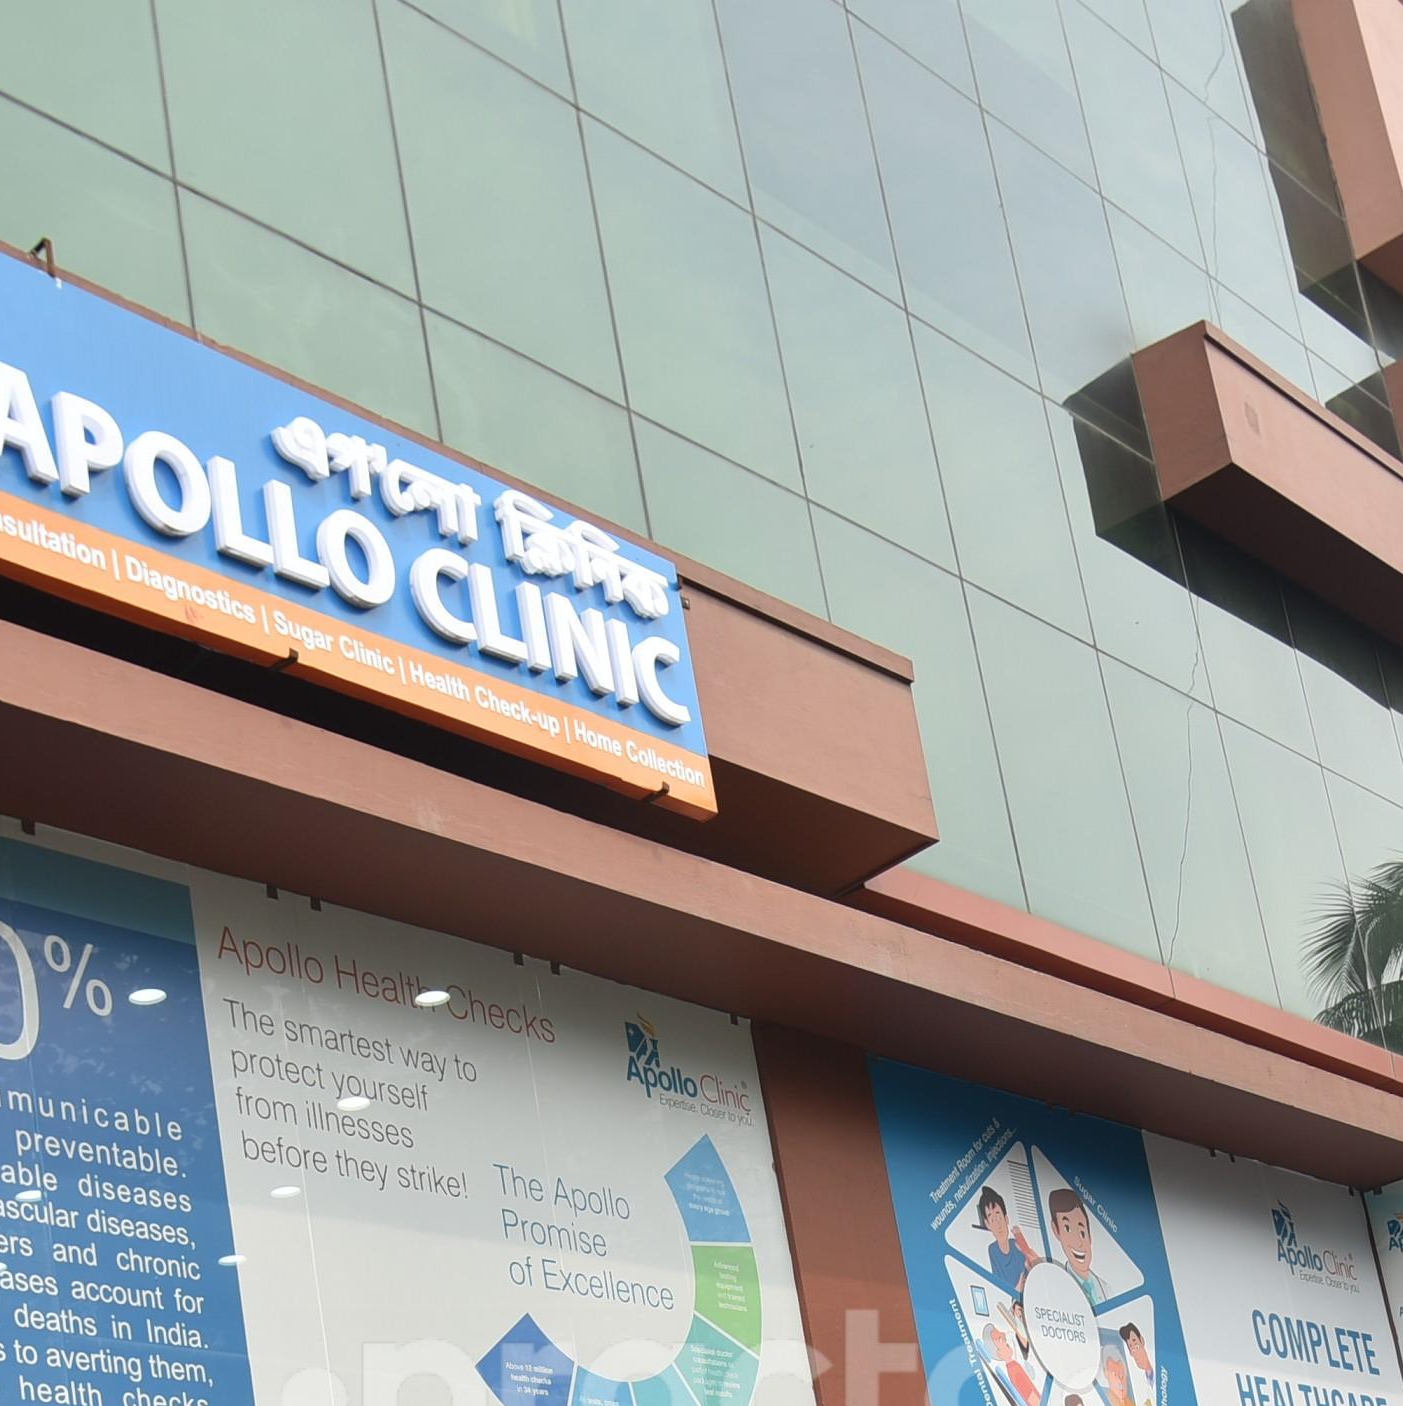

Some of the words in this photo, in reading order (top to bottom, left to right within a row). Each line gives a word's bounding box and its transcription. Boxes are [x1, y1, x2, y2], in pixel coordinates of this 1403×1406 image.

[410, 547, 692, 728] CLINIC
[126, 556, 258, 625] Diagnostics
[274, 610, 334, 652] Sugar
[339, 636, 395, 675] Clinic
[410, 664, 471, 703] Health
[475, 687, 561, 738] Check-up
[574, 720, 623, 757] Home
[626, 740, 706, 788] Collection
[217, 926, 324, 986] Apollo
[446, 984, 556, 1044] Checks
[223, 998, 275, 1037] The
[284, 1015, 393, 1065] smartest
[399, 1046, 448, 1082] way
[453, 1054, 477, 1082] to
[231, 1047, 324, 1090] protect
[332, 1069, 429, 1112] yourself
[627, 1055, 698, 1098] Apollo
[700, 1074, 752, 1112] Clinic
[236, 1087, 297, 1126] from
[306, 1101, 414, 1149] illnesses
[16, 1127, 188, 1179] preventable.
[242, 1130, 327, 1174] before
[336, 1151, 389, 1191] they
[397, 1163, 468, 1200] strike!
[494, 1163, 544, 1202] The
[554, 1175, 631, 1221] Apollo
[1074, 1176, 1096, 1206] Sugar
[1096, 1203, 1118, 1233] Clinic
[501, 1208, 608, 1258] Promise
[71, 1275, 165, 1310] account
[174, 1288, 205, 1315] for
[509, 1256, 533, 1288] of
[543, 1260, 675, 1312] Excellence
[949, 1299, 977, 1365] Treatment
[1034, 1307, 1086, 1327] SPECIALIST
[1041, 1325, 1087, 1344] DOCTORS
[1252, 1309, 1381, 1376] COMPLETE
